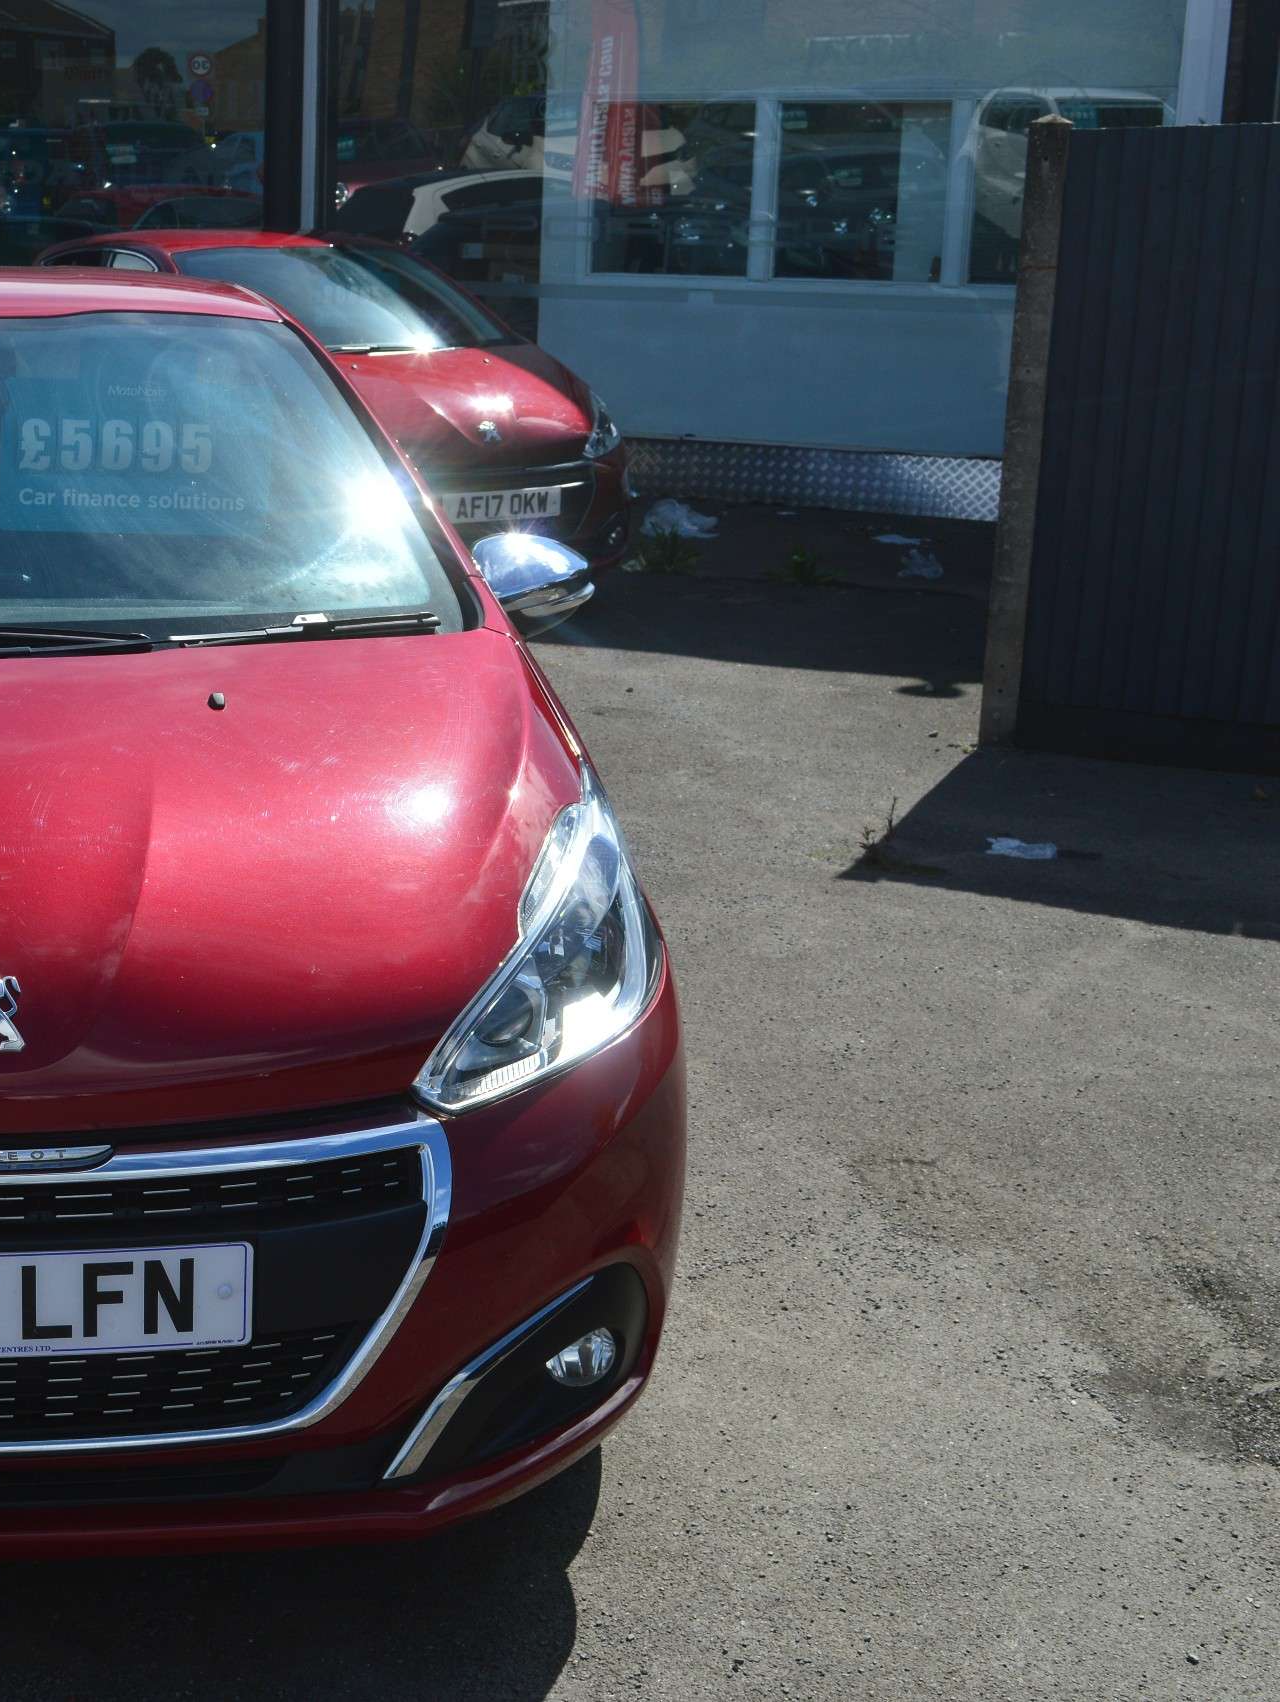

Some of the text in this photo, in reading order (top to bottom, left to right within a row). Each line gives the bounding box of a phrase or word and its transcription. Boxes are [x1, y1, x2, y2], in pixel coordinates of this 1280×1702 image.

[18, 417, 213, 475] £5695
[18, 488, 246, 512] Car finance solutions
[456, 494, 504, 519] AF17
[21, 1257, 195, 1341] LFN
